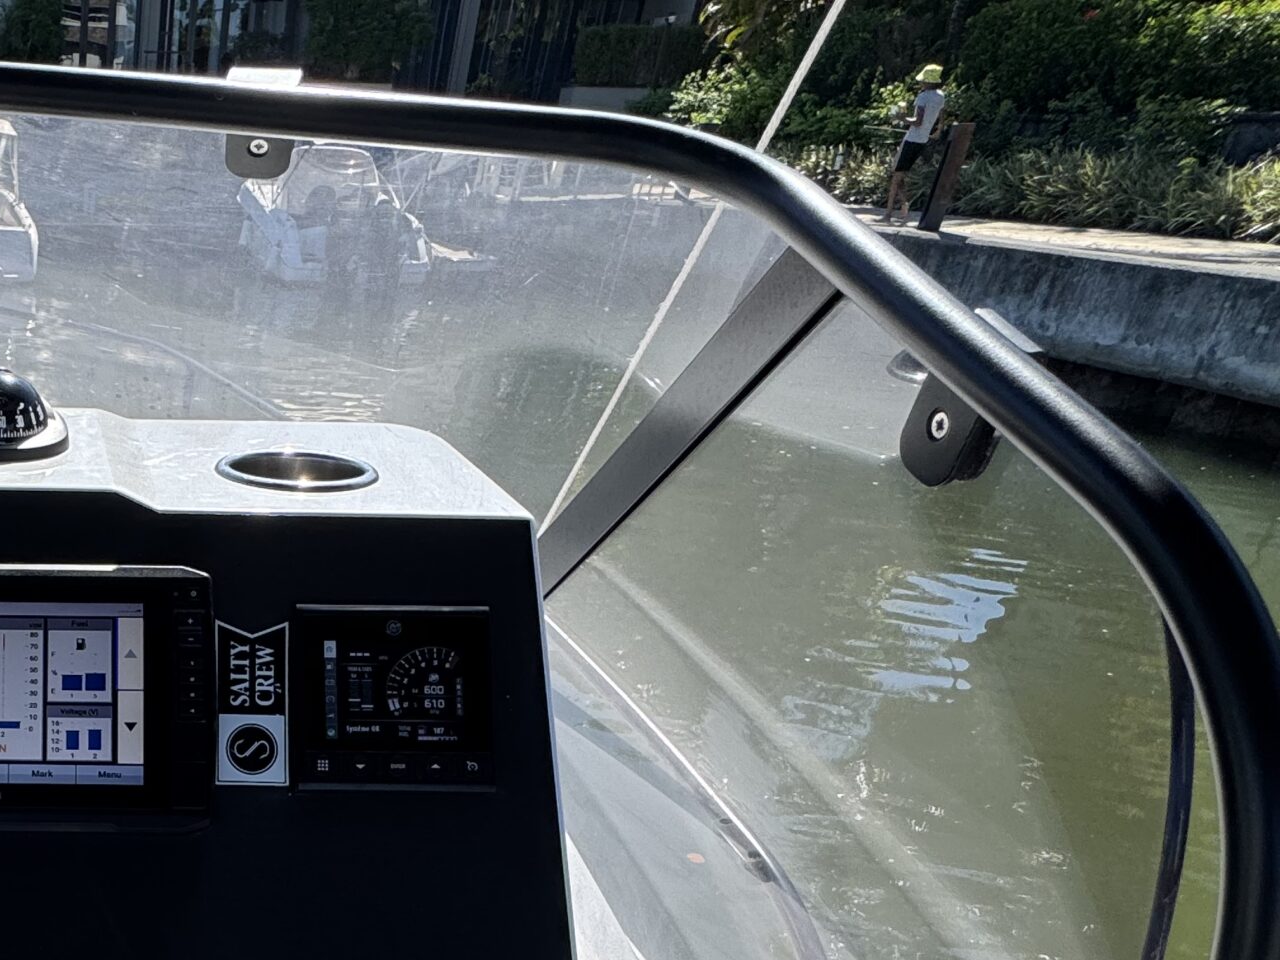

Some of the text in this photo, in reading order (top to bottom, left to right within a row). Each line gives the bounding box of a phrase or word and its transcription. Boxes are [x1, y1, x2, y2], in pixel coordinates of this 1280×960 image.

[230, 640, 250, 707] SALTY
[255, 644, 275, 706] CREW
[423, 685, 445, 695] 600
[424, 698, 445, 709] 610
[31, 769, 53, 778] Mark
[98, 770, 122, 779] Menu
